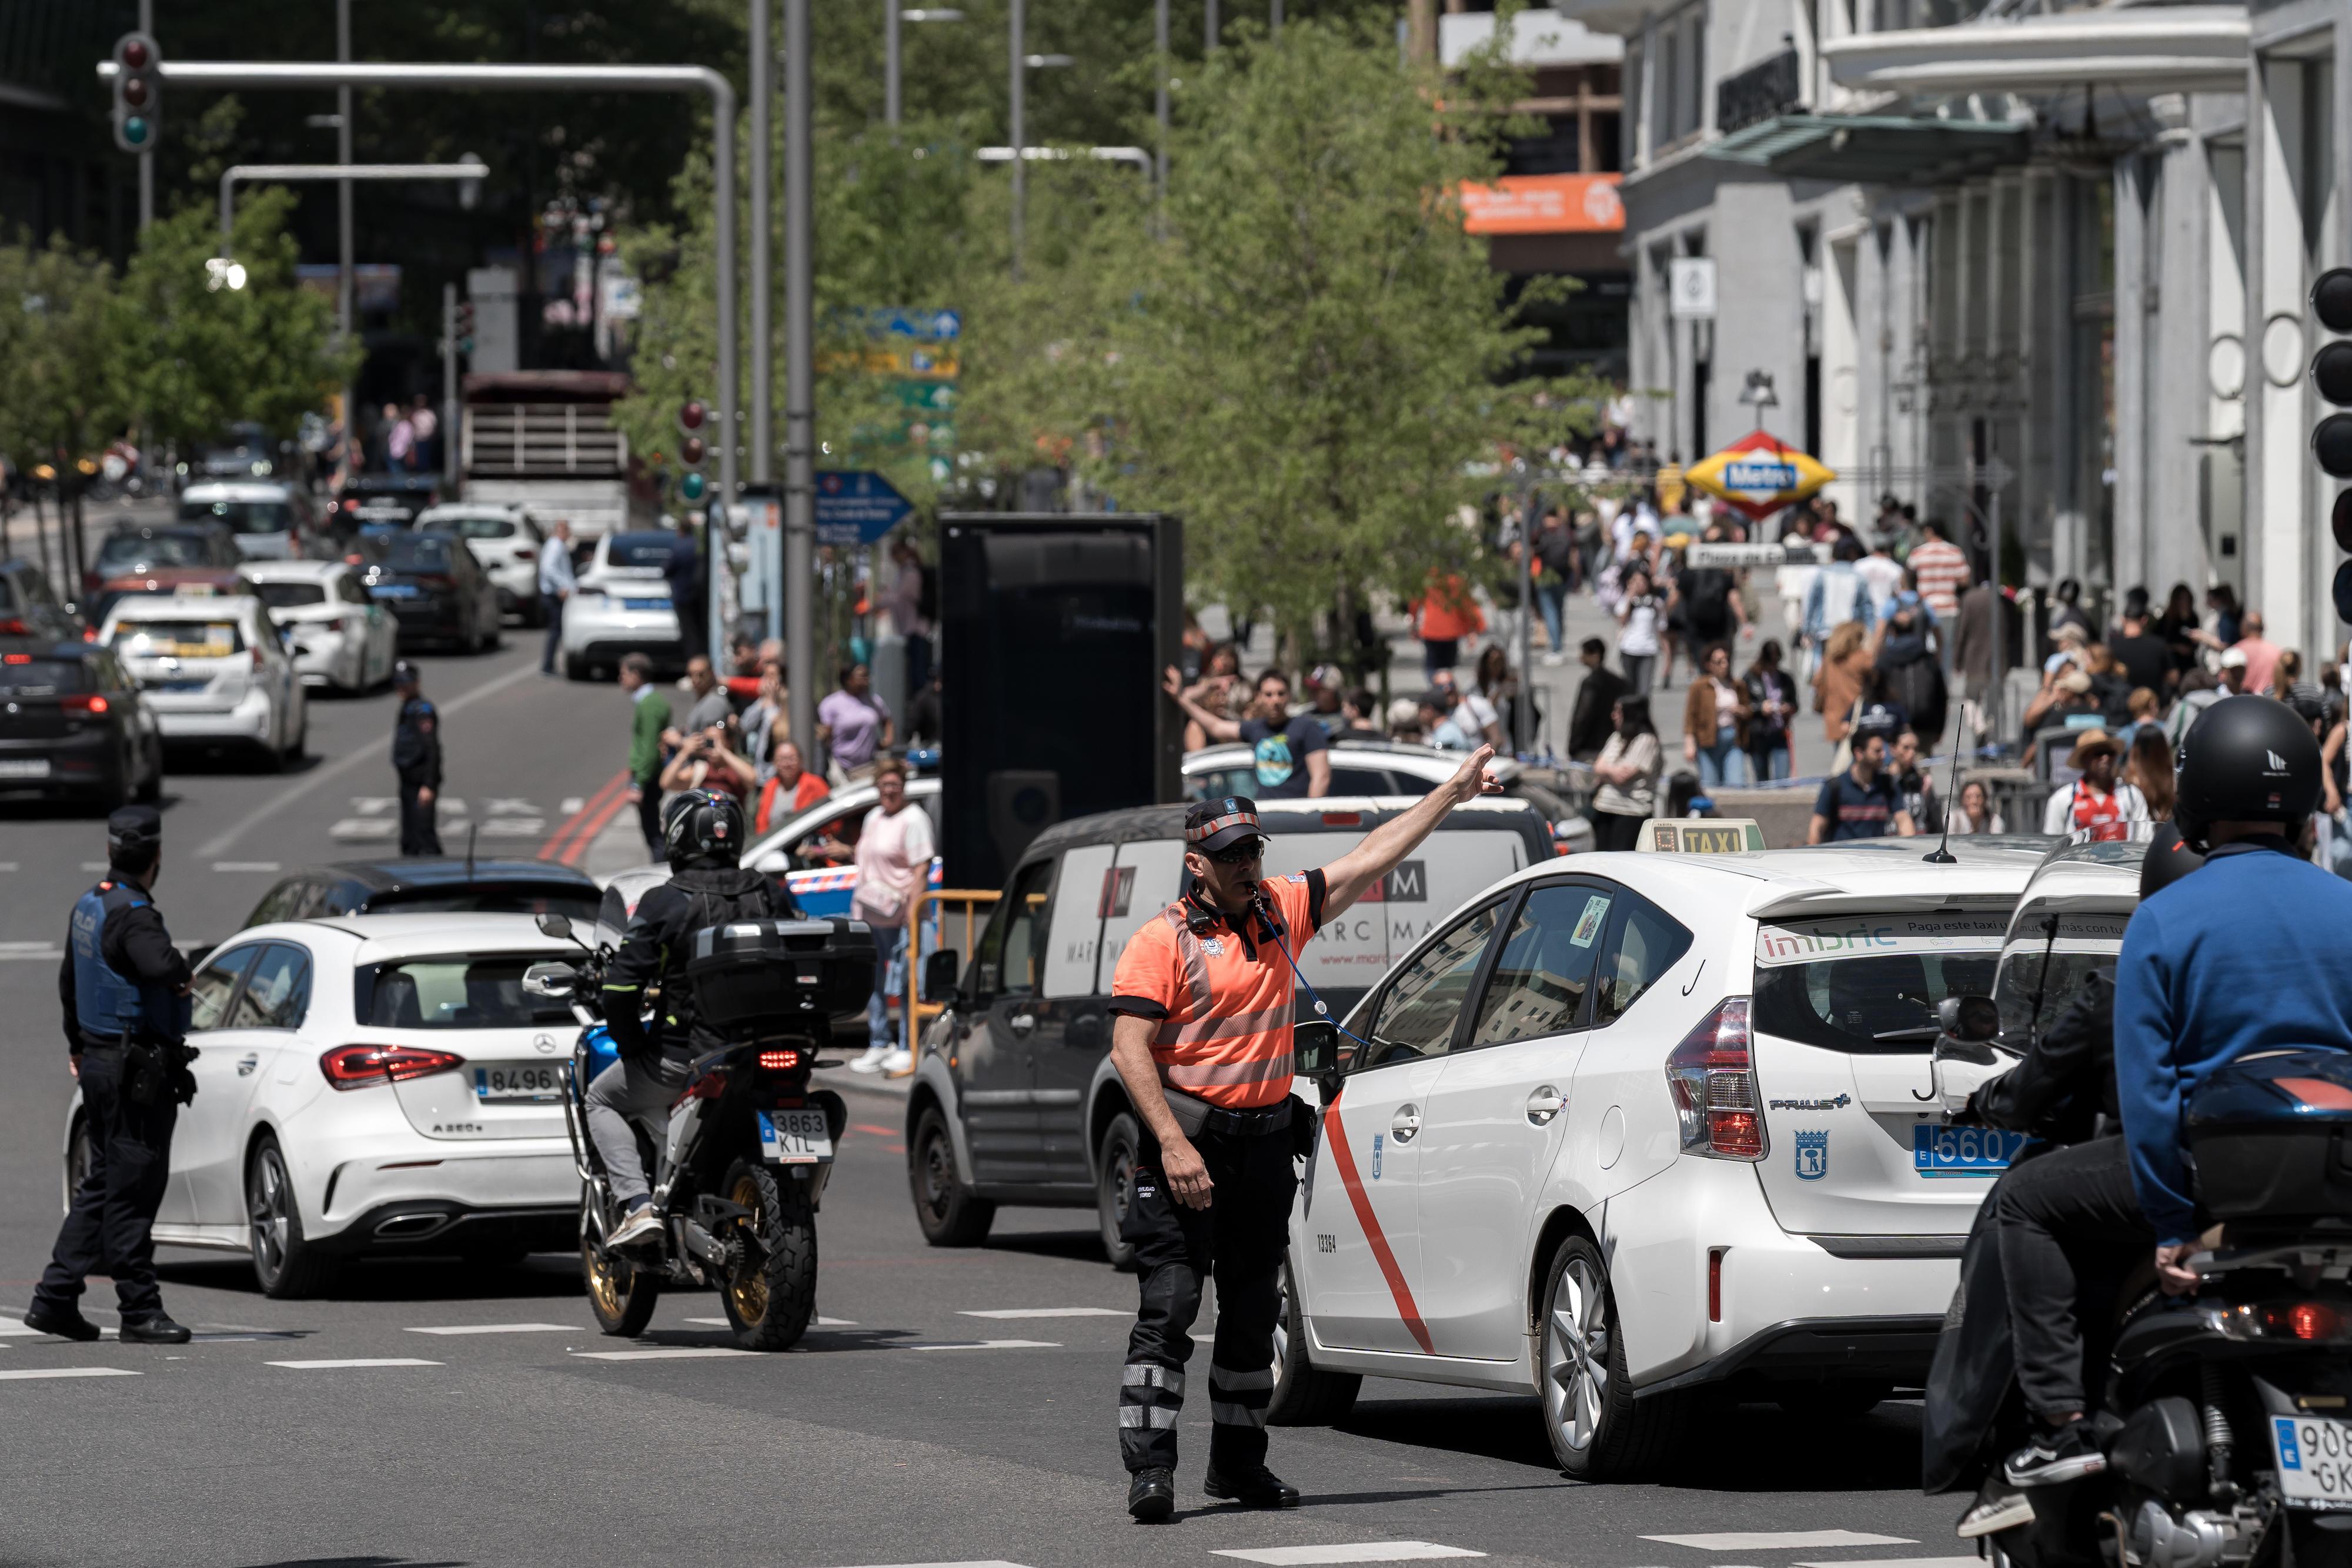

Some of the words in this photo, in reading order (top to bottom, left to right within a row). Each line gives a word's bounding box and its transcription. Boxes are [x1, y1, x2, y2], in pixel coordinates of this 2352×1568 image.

[1729, 464, 1792, 487] Metro
[1686, 832, 1740, 852] TAXI
[1392, 868, 1420, 895] M
[1312, 920, 1371, 942] ARC
[1392, 920, 1435, 940] MA
[1908, 921, 1940, 933] Paga
[1944, 920, 1970, 930] este
[1973, 920, 1996, 930] taxi
[2000, 922, 2007, 931] y
[2020, 923, 2047, 933] muc
[2058, 922, 2083, 933] más
[2086, 924, 2109, 934] con
[2110, 924, 2123, 935] tu
[1763, 923, 1897, 957] imbric
[1065, 941, 1096, 963] MAR
[1682, 959, 1706, 997] J
[492, 1069, 552, 1092] 8496
[777, 1115, 823, 1132] 3863
[779, 1135, 815, 1153] KTL
[1919, 1151, 1927, 1161] E
[1317, 1234, 1336, 1253] 13364
[2283, 1448, 2297, 1463] E
